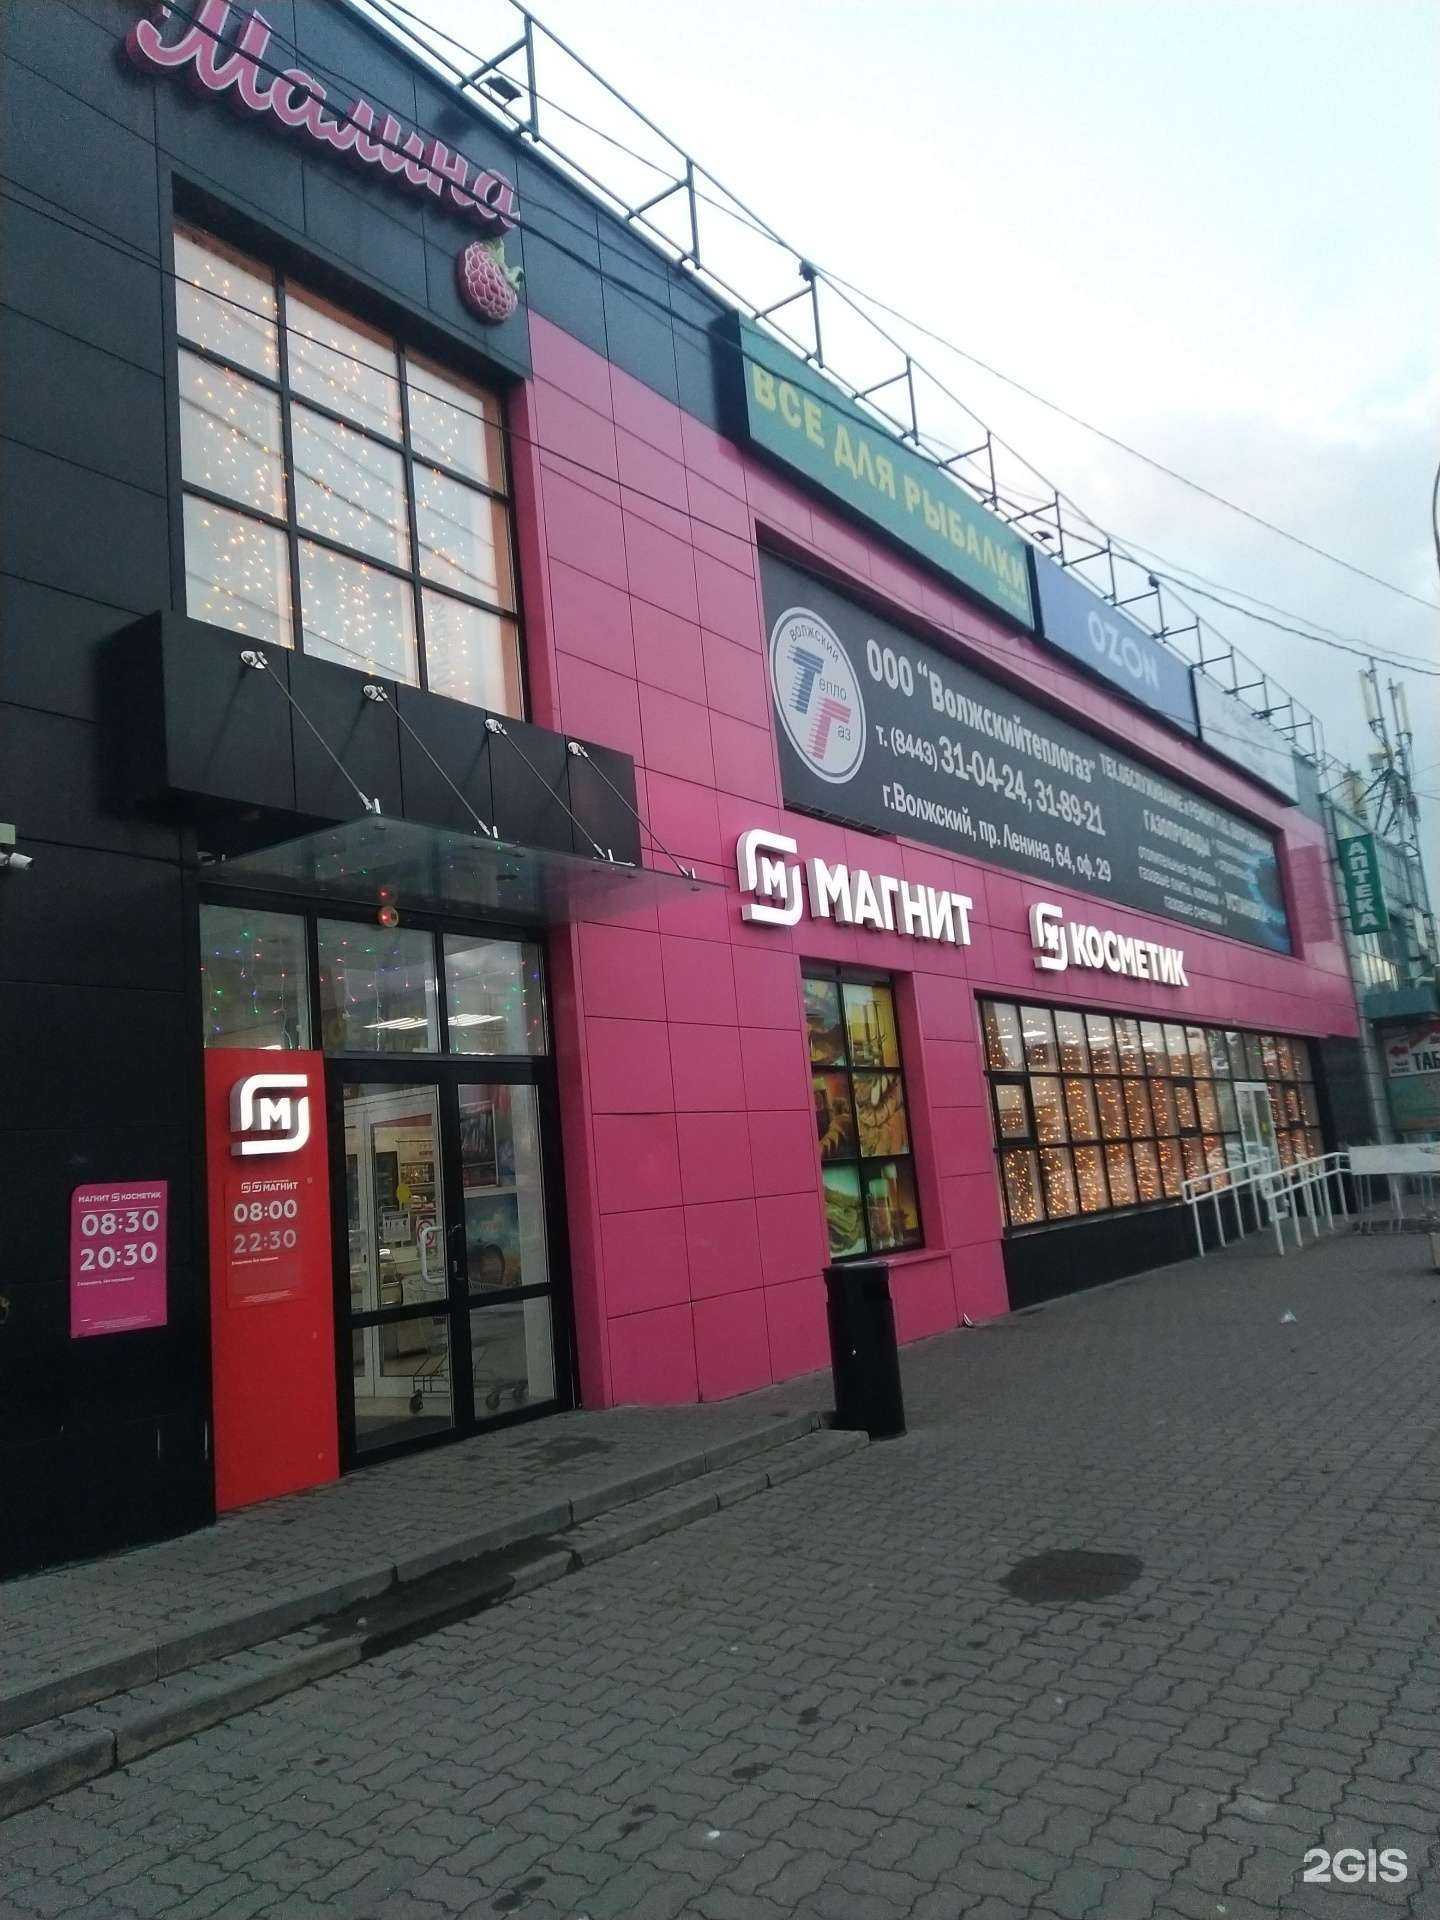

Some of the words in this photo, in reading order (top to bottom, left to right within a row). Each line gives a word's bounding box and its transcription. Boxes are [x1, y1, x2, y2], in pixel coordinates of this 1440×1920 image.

[753, 363, 825, 449] ВСЕ
[834, 424, 896, 500] ДЛЯ
[903, 474, 1026, 590] РЫБАЛКИ
[866, 638, 914, 697] ООО
[1087, 610, 1160, 691] OZON
[875, 724, 888, 748] т.
[890, 726, 938, 772] (8443)
[939, 735, 1033, 813] 31-04-24,
[1033, 778, 1106, 837] 31-89-21
[978, 820, 1001, 849] пр.
[1003, 824, 1055, 868] Ленина,
[1055, 843, 1076, 875] 64,
[1076, 854, 1096, 881] оф.
[1097, 856, 1112, 883] 29
[807, 857, 973, 946] МАГНИТ
[1348, 840, 1380, 928] АПТЕКА
[1069, 921, 1189, 987] КОСМЕТИК
[78, 1194, 110, 1204] МАГНИТ
[121, 1191, 162, 1201] КОСМЕТИК
[233, 1199, 298, 1223] 08:00
[262, 1182, 299, 1192] МАГНИТ
[81, 1209, 160, 1237] 08:30
[233, 1229, 297, 1255] 22:30
[79, 1241, 158, 1271] 20:30
